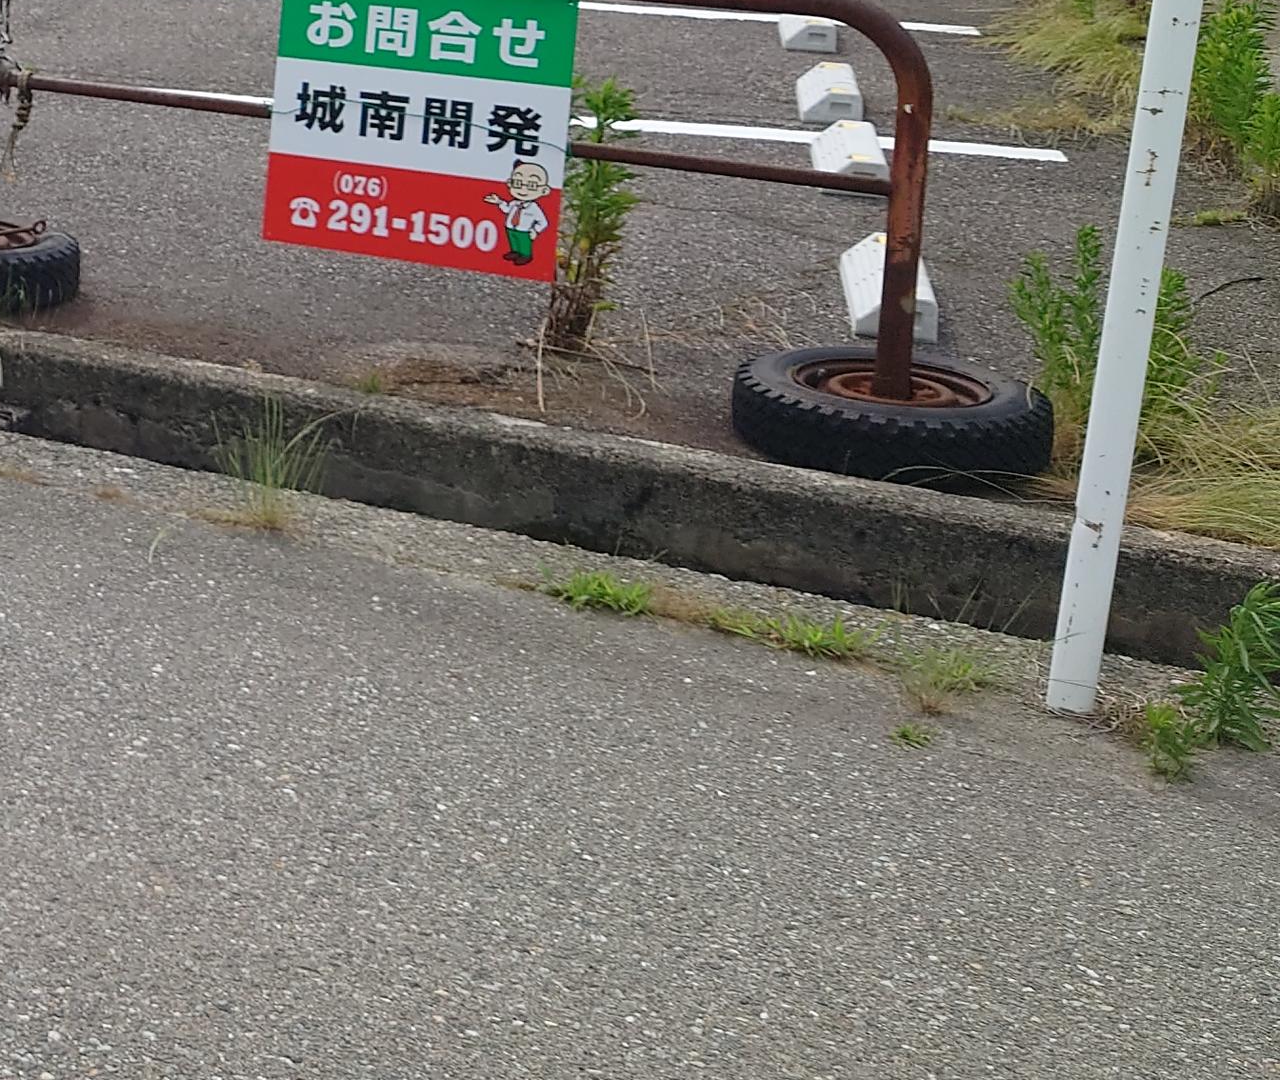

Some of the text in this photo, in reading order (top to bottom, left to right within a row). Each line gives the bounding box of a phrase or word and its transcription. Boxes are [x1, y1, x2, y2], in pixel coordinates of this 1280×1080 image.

[306, 0, 546, 68] お問合せ
[294, 82, 542, 157] 城南開発
[333, 171, 388, 200] (076)
[327, 199, 498, 252] 291-1500
